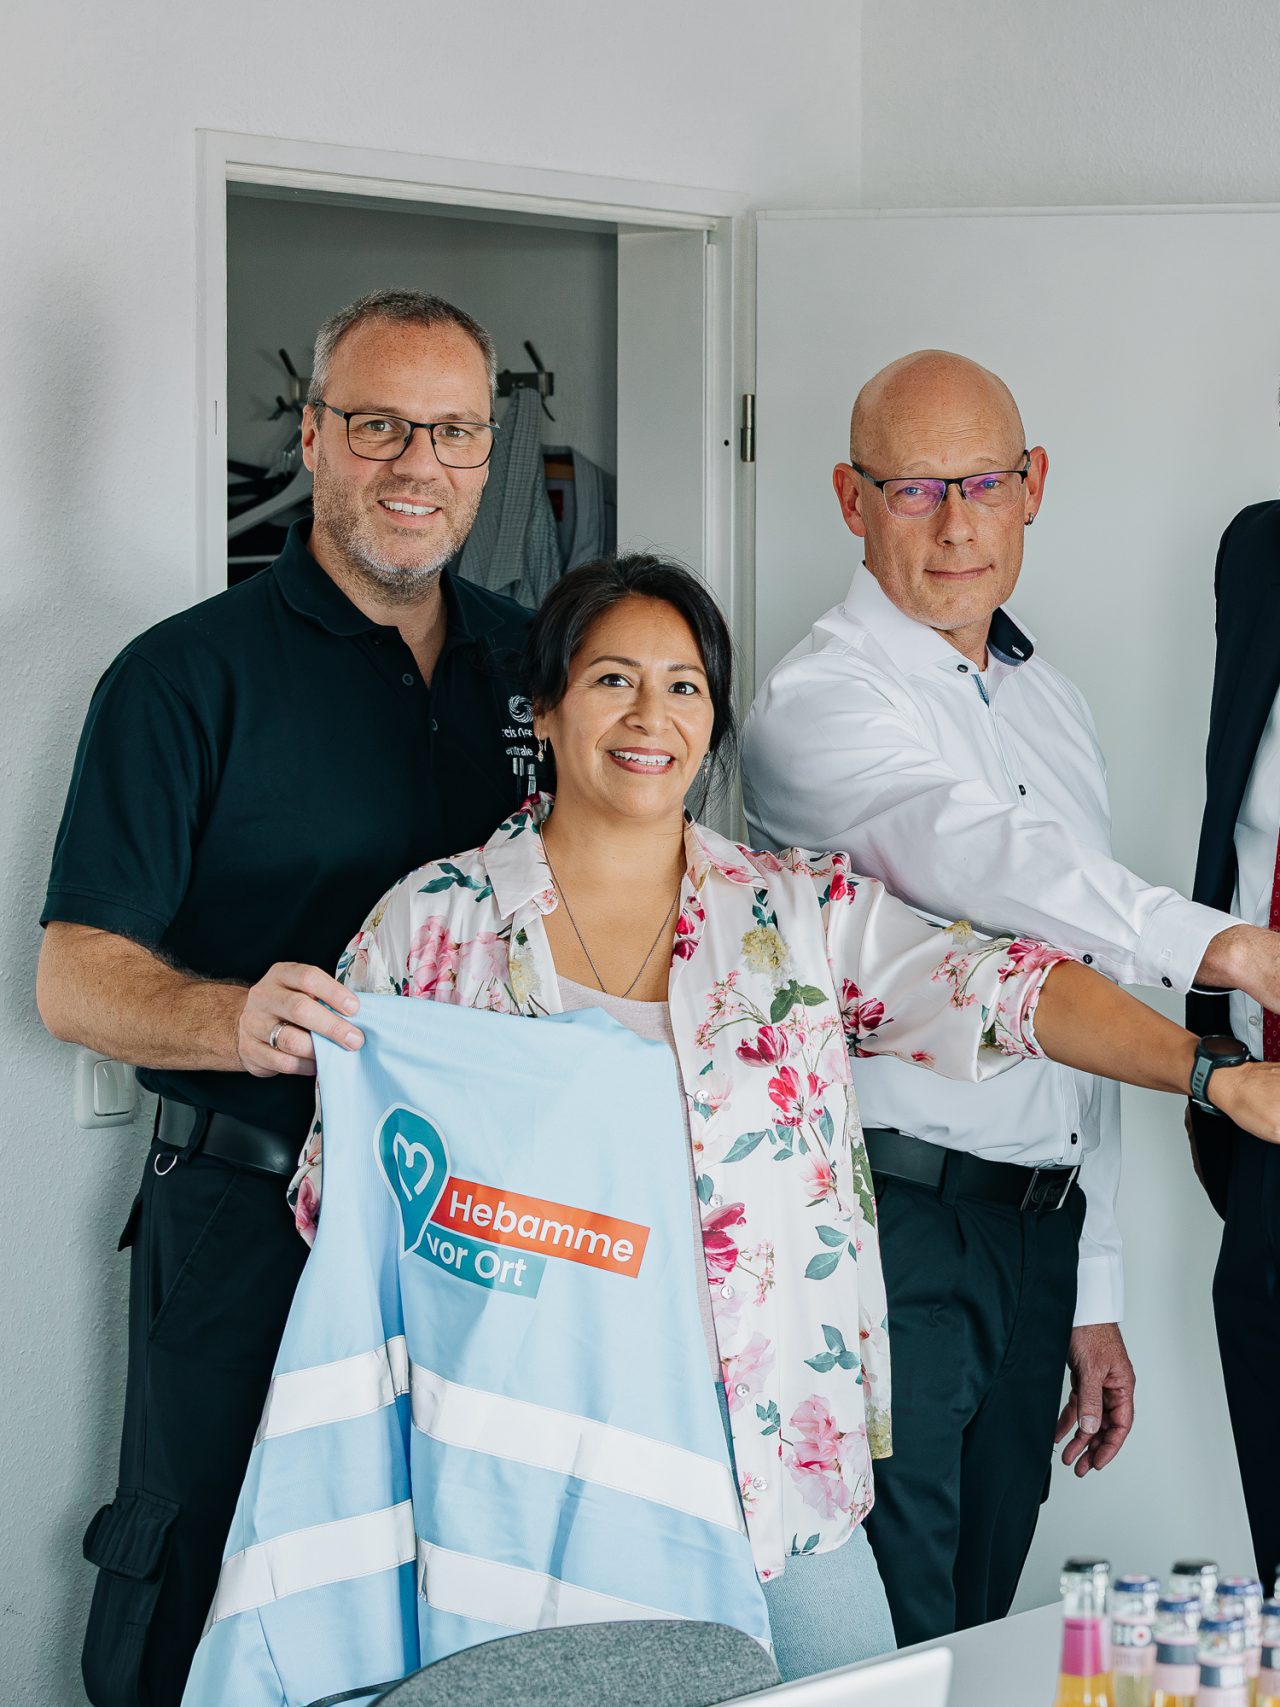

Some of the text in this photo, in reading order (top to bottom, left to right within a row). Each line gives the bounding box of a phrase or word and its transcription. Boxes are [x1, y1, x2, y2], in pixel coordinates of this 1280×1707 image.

[448, 1190, 635, 1264] Hebamme
[426, 1232, 528, 1288] vor Ort
